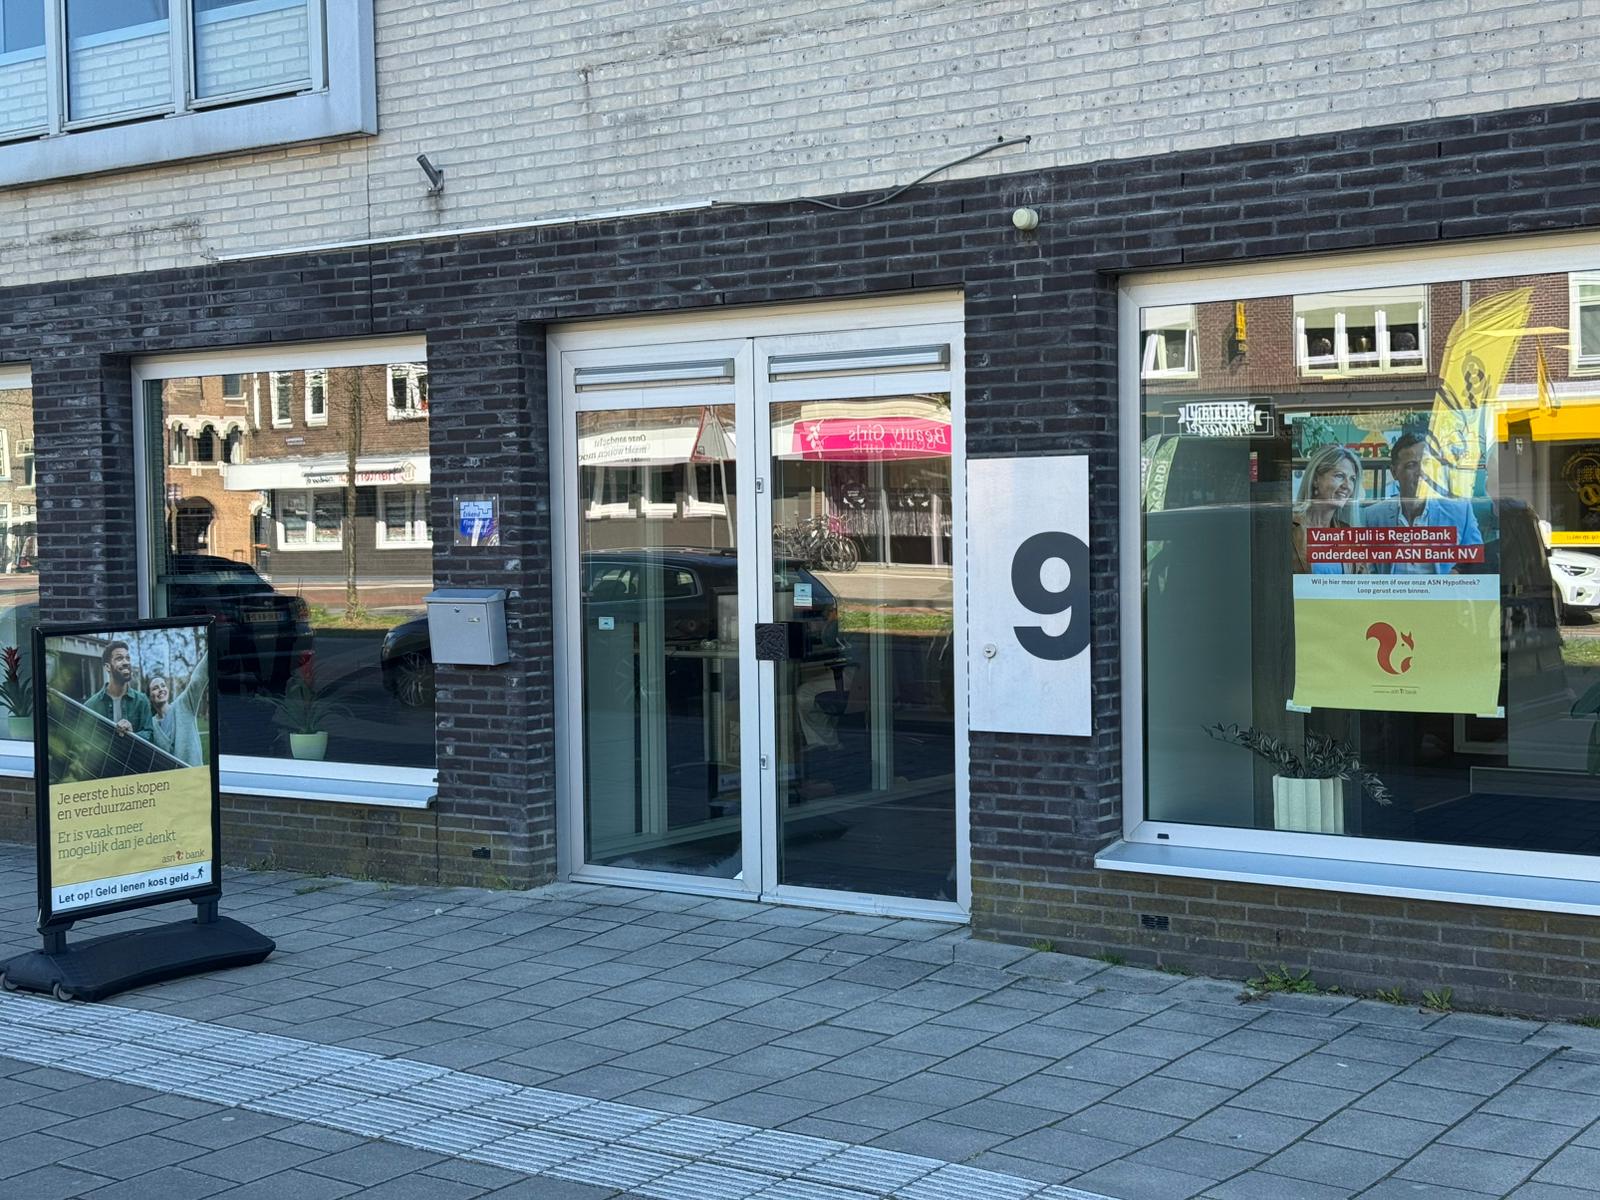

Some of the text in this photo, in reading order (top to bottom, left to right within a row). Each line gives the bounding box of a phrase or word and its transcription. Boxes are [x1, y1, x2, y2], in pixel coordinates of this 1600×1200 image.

[1311, 529, 1451, 544] Vanaf 1 juli is RegioBank
[1311, 548, 1478, 560] onderdeel van ASN Bank NV
[1443, 579, 1480, 587] Hypotheek?
[1011, 531, 1090, 661] 9
[57, 780, 170, 805] Je eerste huis kopen
[57, 797, 156, 821] en verduurzamen
[58, 821, 144, 844] Er is vaak meer
[58, 830, 177, 860] mogelijk dan je denkt
[161, 848, 205, 864] asn bank
[58, 871, 189, 904] Let op! Geld lenen kost geld
